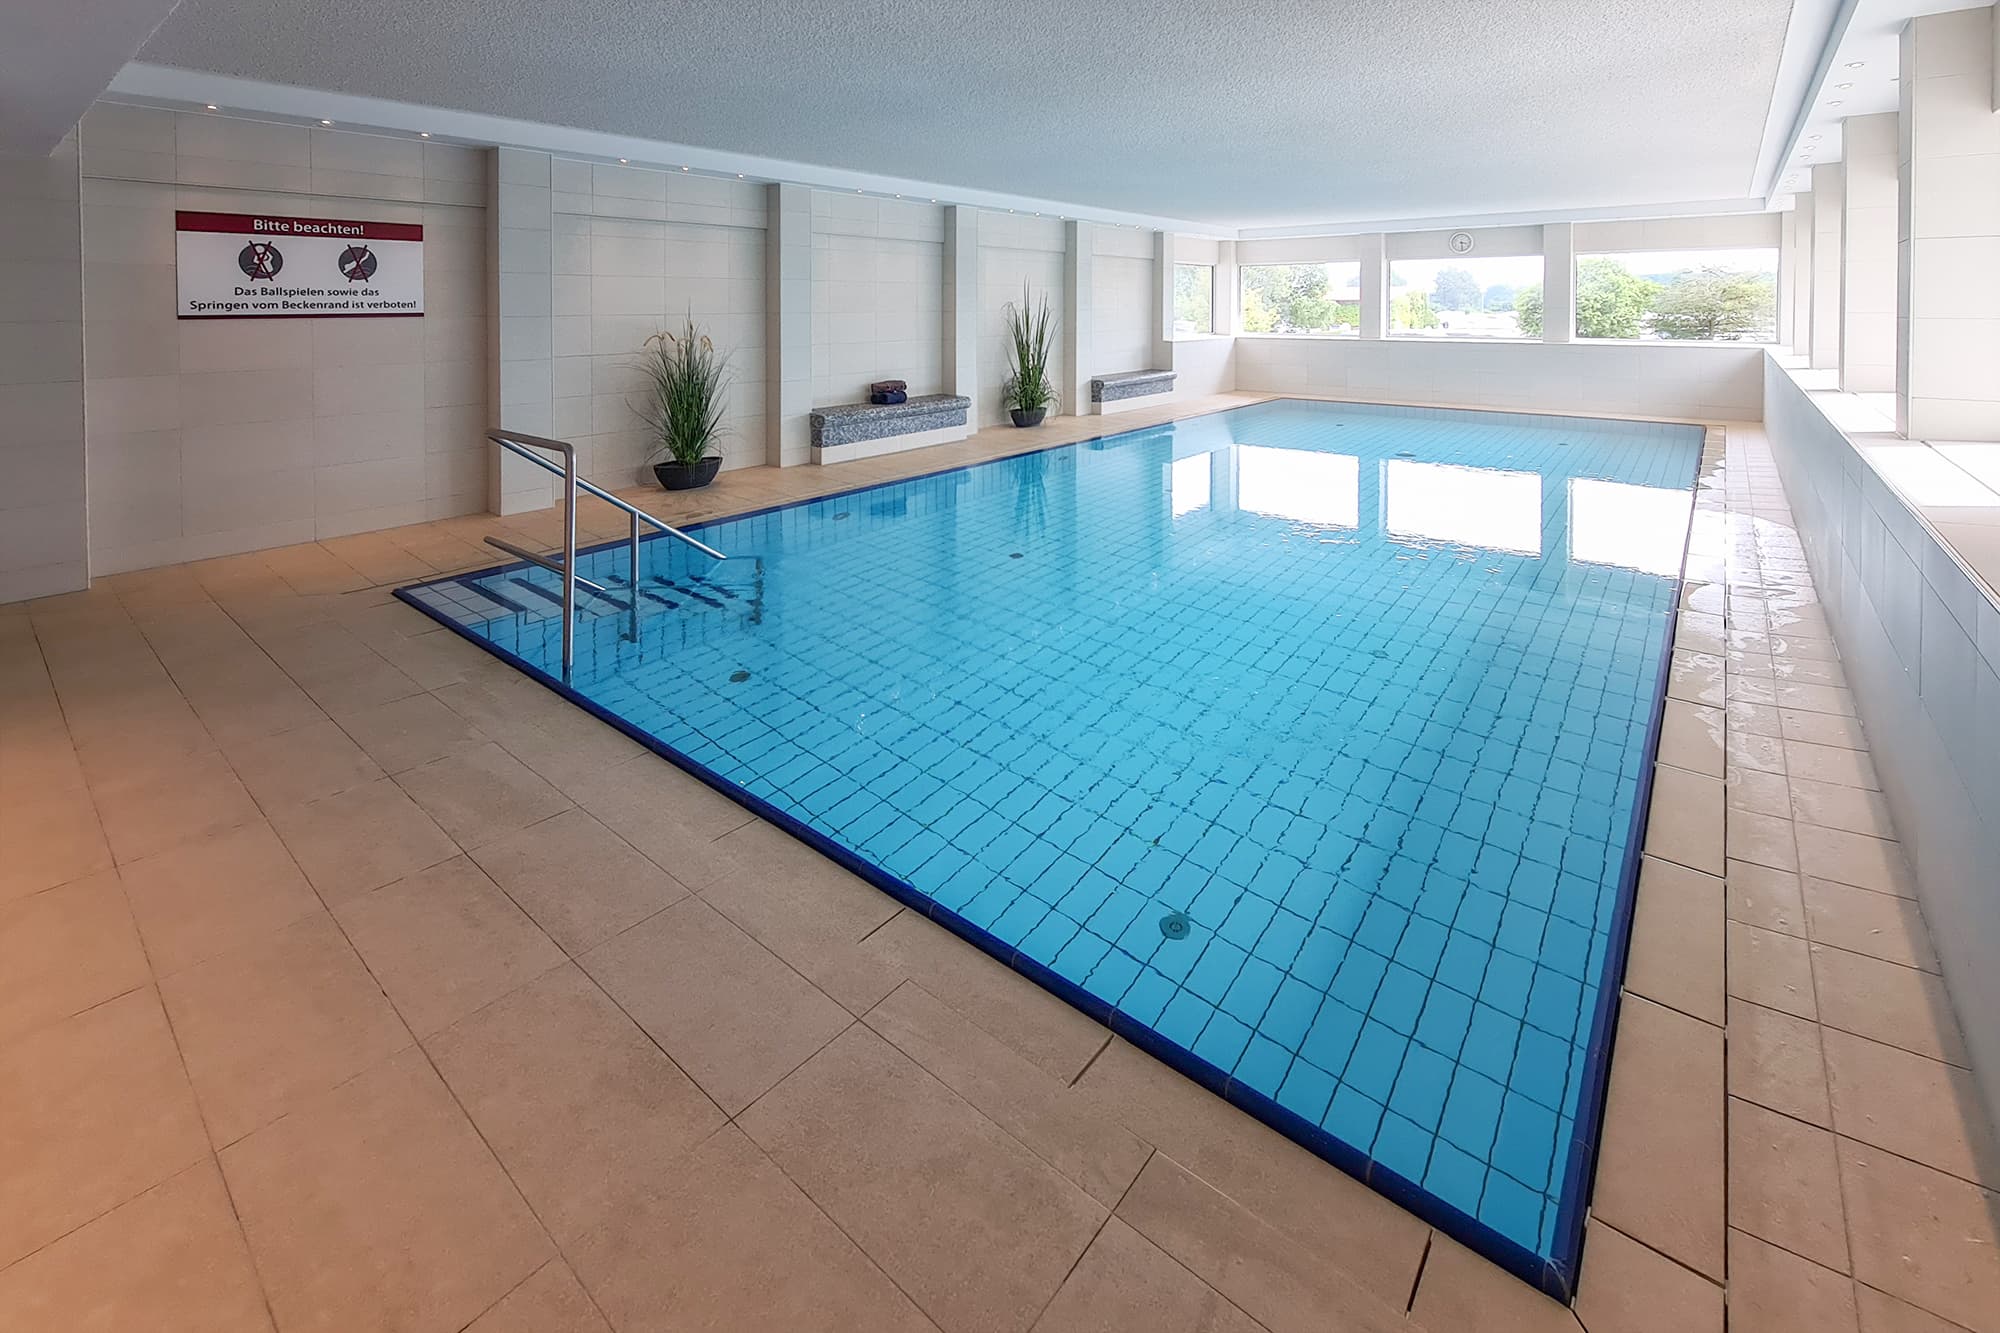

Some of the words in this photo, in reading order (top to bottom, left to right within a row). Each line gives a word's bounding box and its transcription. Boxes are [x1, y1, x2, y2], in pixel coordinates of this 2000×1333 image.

[253, 219, 290, 232] Bitte
[293, 221, 364, 235] beachten!
[234, 287, 257, 297] Das
[260, 287, 324, 298] Ballspielen
[327, 287, 358, 297] sowie
[361, 287, 379, 297] das
[189, 300, 249, 312] Springen
[251, 302, 279, 310] vom
[282, 300, 349, 310] Beckenrand
[351, 300, 365, 309] ist
[366, 300, 417, 310] verboten!
